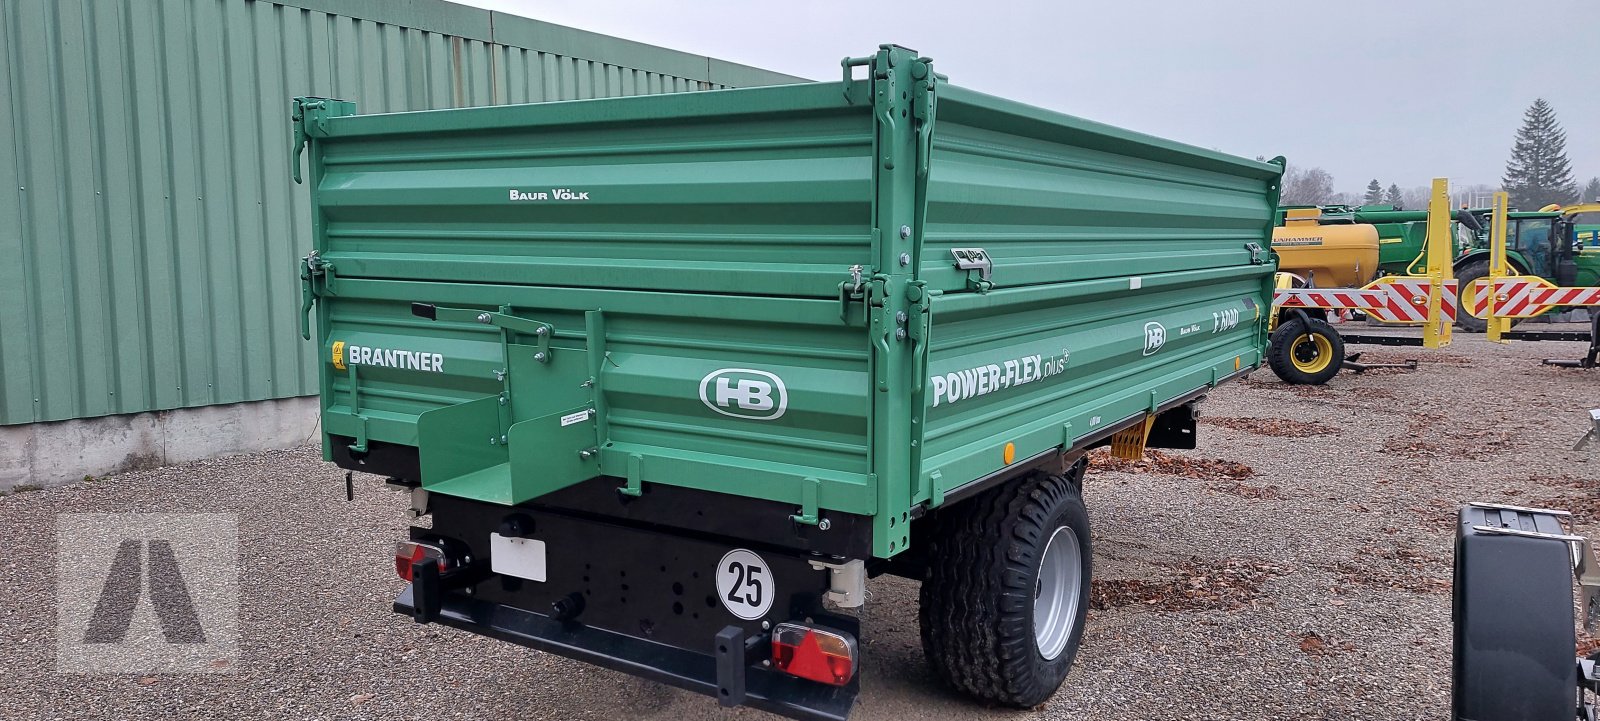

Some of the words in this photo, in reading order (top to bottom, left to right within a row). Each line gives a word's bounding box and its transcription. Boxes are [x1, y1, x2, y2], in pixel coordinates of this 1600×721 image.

[509, 189, 548, 201] BAUR
[551, 188, 590, 200] VÖLK
[349, 345, 444, 373] BRANTNER
[716, 377, 774, 411] HB
[930, 354, 1042, 408] POWER-FLEX
[727, 561, 762, 608] 25
